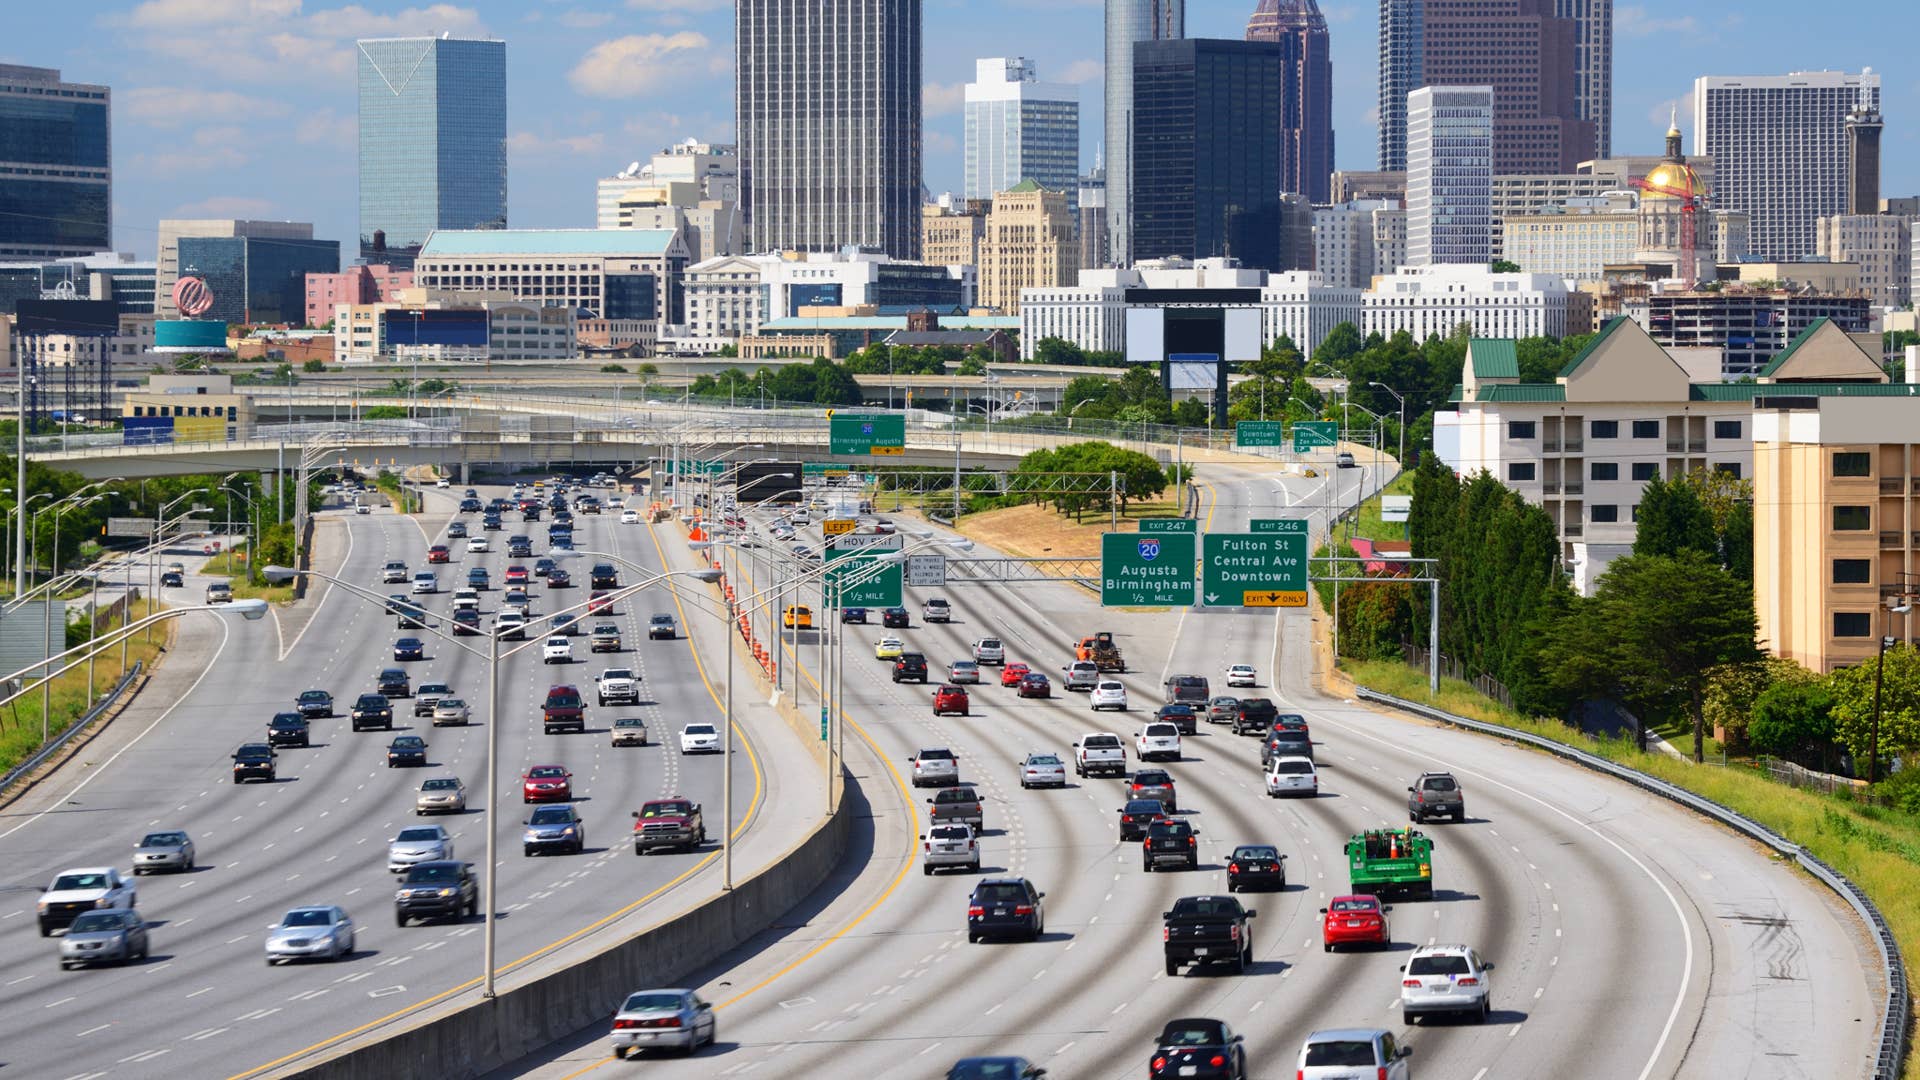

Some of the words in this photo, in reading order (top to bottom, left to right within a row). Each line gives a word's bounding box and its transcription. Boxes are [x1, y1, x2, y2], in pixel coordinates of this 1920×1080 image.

[832, 437, 871, 446] Birmingham
[827, 523, 851, 532] LEFT
[1166, 522, 1187, 530] 247
[1277, 522, 1299, 530] 246
[843, 538, 865, 546] HOV
[1222, 540, 1267, 551] Fulton
[1274, 540, 1289, 551] St
[1141, 543, 1159, 557] 20
[1214, 555, 1265, 566] Central
[1272, 555, 1297, 566] Ave
[1120, 565, 1178, 577] Augusta
[1221, 571, 1291, 581] Downtown
[1106, 579, 1192, 592] Birmingham
[865, 592, 885, 600] MILE
[1154, 594, 1174, 602] MILE
[1246, 595, 1265, 603] EXIT
[1282, 595, 1304, 603] ONLY
